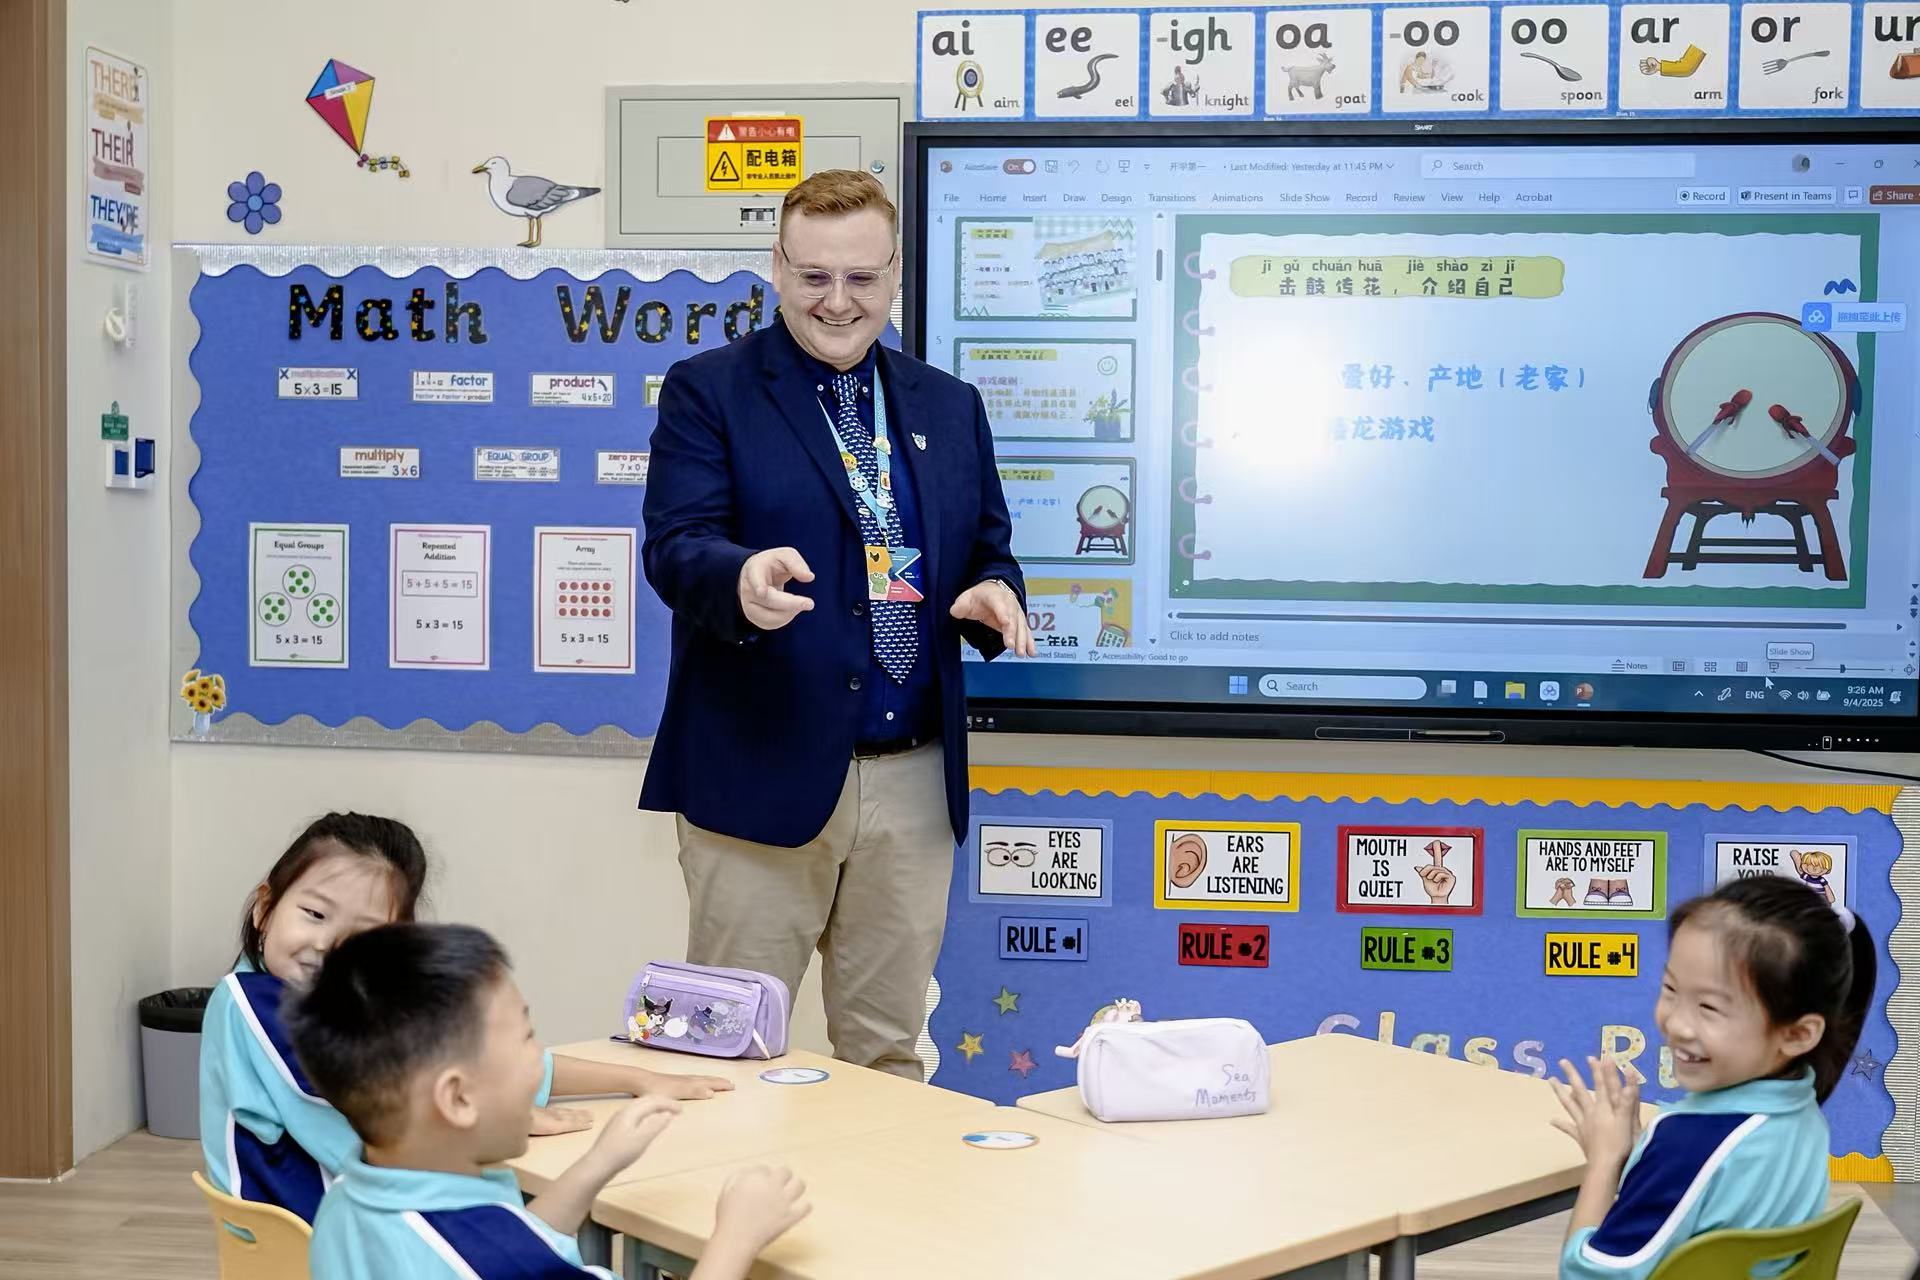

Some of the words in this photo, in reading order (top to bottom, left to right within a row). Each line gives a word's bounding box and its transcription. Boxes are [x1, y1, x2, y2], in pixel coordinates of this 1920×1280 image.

[1389, 20, 1460, 47] -oo
[1511, 18, 1568, 45] oo
[1630, 16, 1680, 44] ar
[1750, 15, 1801, 43] or
[1874, 15, 1920, 43] ur
[932, 19, 975, 56] ai
[1045, 25, 1092, 52] ee
[1156, 16, 1232, 65] -igh
[1275, 23, 1333, 50] oa
[1115, 95, 1134, 108] eel
[1204, 93, 1250, 110] knight
[1334, 93, 1367, 108] goat
[1450, 90, 1484, 103] cook
[1560, 91, 1603, 105] spoon
[1693, 89, 1723, 101] arm
[1811, 86, 1844, 104] fork
[993, 97, 1020, 108] aim
[91, 128, 134, 168] THEIR
[747, 149, 797, 167] 配电箱
[1230, 163, 1248, 171] Last
[1291, 163, 1330, 173] Yesterday
[1332, 163, 1341, 171] at
[1344, 163, 1367, 171] 11:45
[1369, 163, 1383, 171] PM
[1453, 160, 1484, 172] Search
[944, 194, 960, 202] File
[979, 194, 1007, 202] Home
[1022, 194, 1047, 202] Insert
[1063, 194, 1087, 202] Draw
[1101, 194, 1132, 204] Design
[1149, 193, 1196, 202] Transitions
[1211, 193, 1263, 202] Animations
[1279, 193, 1303, 202] Slide
[1305, 193, 1330, 202] Show
[1345, 193, 1378, 202] Record
[1393, 193, 1425, 202] Review
[1440, 192, 1464, 202] View
[1478, 192, 1500, 204] Help
[1515, 192, 1553, 202] Acrobat
[1692, 189, 1726, 201] Record
[1753, 189, 1787, 201] Present
[1789, 189, 1800, 201] in
[1802, 190, 1832, 202] Teams
[1886, 189, 1914, 202] Share
[937, 215, 943, 224] 4
[1436, 259, 1469, 272] shào
[288, 281, 489, 345] Math
[555, 283, 783, 346] Word
[936, 336, 942, 344] 5
[450, 374, 489, 387] factor
[549, 376, 597, 390] product
[1342, 363, 1586, 392] 好、产地（老家）
[294, 382, 303, 396] 5
[331, 383, 343, 396] 15
[355, 449, 405, 463] multiply
[487, 450, 513, 461] EQUAL
[392, 464, 400, 476] 3
[410, 465, 418, 476] 6
[620, 463, 625, 471] 7
[635, 463, 641, 471] 0
[274, 540, 296, 551] Equal
[297, 541, 325, 551] Groups
[422, 542, 457, 551] Repeated
[575, 545, 596, 555] Array
[423, 552, 457, 561] Addition
[407, 578, 413, 588] 5
[415, 580, 422, 588] +
[424, 578, 431, 588] 5
[433, 580, 440, 588] +
[443, 579, 449, 589] 5
[461, 579, 473, 590] 15
[416, 619, 422, 629] 5
[433, 619, 440, 629] 3
[452, 620, 464, 630] 15
[1027, 611, 1057, 632] 02
[276, 634, 282, 644] 5
[293, 634, 299, 644] 3
[312, 635, 323, 645] 15
[561, 633, 567, 643] 5
[578, 633, 585, 643] 3
[598, 634, 609, 644] 15
[1170, 630, 1193, 641] Click
[1196, 632, 1207, 641] to
[1209, 631, 1229, 641] add
[1232, 632, 1260, 642] notes
[1148, 653, 1168, 662] Good
[1177, 655, 1188, 663] go
[1769, 647, 1789, 656] Slide
[1790, 648, 1811, 657] Show
[1626, 661, 1648, 671] Notes
[1286, 681, 1319, 692] Search
[1847, 685, 1867, 695] 9:26
[1868, 685, 1884, 695] AM
[1745, 690, 1765, 699] ENG
[1843, 698, 1884, 708] 9/4/2025
[1048, 831, 1081, 849] EYES
[1226, 835, 1264, 853] EARS
[1356, 838, 1407, 857] MOUTH
[1539, 841, 1582, 857] HANDS
[1584, 842, 1612, 857] AND
[1613, 842, 1642, 858] FEET
[1051, 852, 1078, 869] ARE
[1733, 848, 1779, 866] RAISE
[1231, 856, 1259, 874] ARE
[1372, 859, 1389, 877] IS
[1545, 856, 1569, 872] ARE
[1570, 857, 1587, 872] TO
[1589, 857, 1635, 873] MYSELF
[1031, 871, 1097, 890] LOOKING
[1207, 876, 1284, 895] LISTENING
[1358, 880, 1404, 899] QUIET
[1006, 925, 1057, 953] RULE
[1182, 932, 1233, 961] RULE
[1364, 935, 1416, 964] RULE
[1421, 937, 1450, 965] #3
[1548, 941, 1601, 970] RULE
[1607, 942, 1635, 970] #4
[1221, 1063, 1250, 1086] Sea
[1195, 1088, 1257, 1108] Moments
